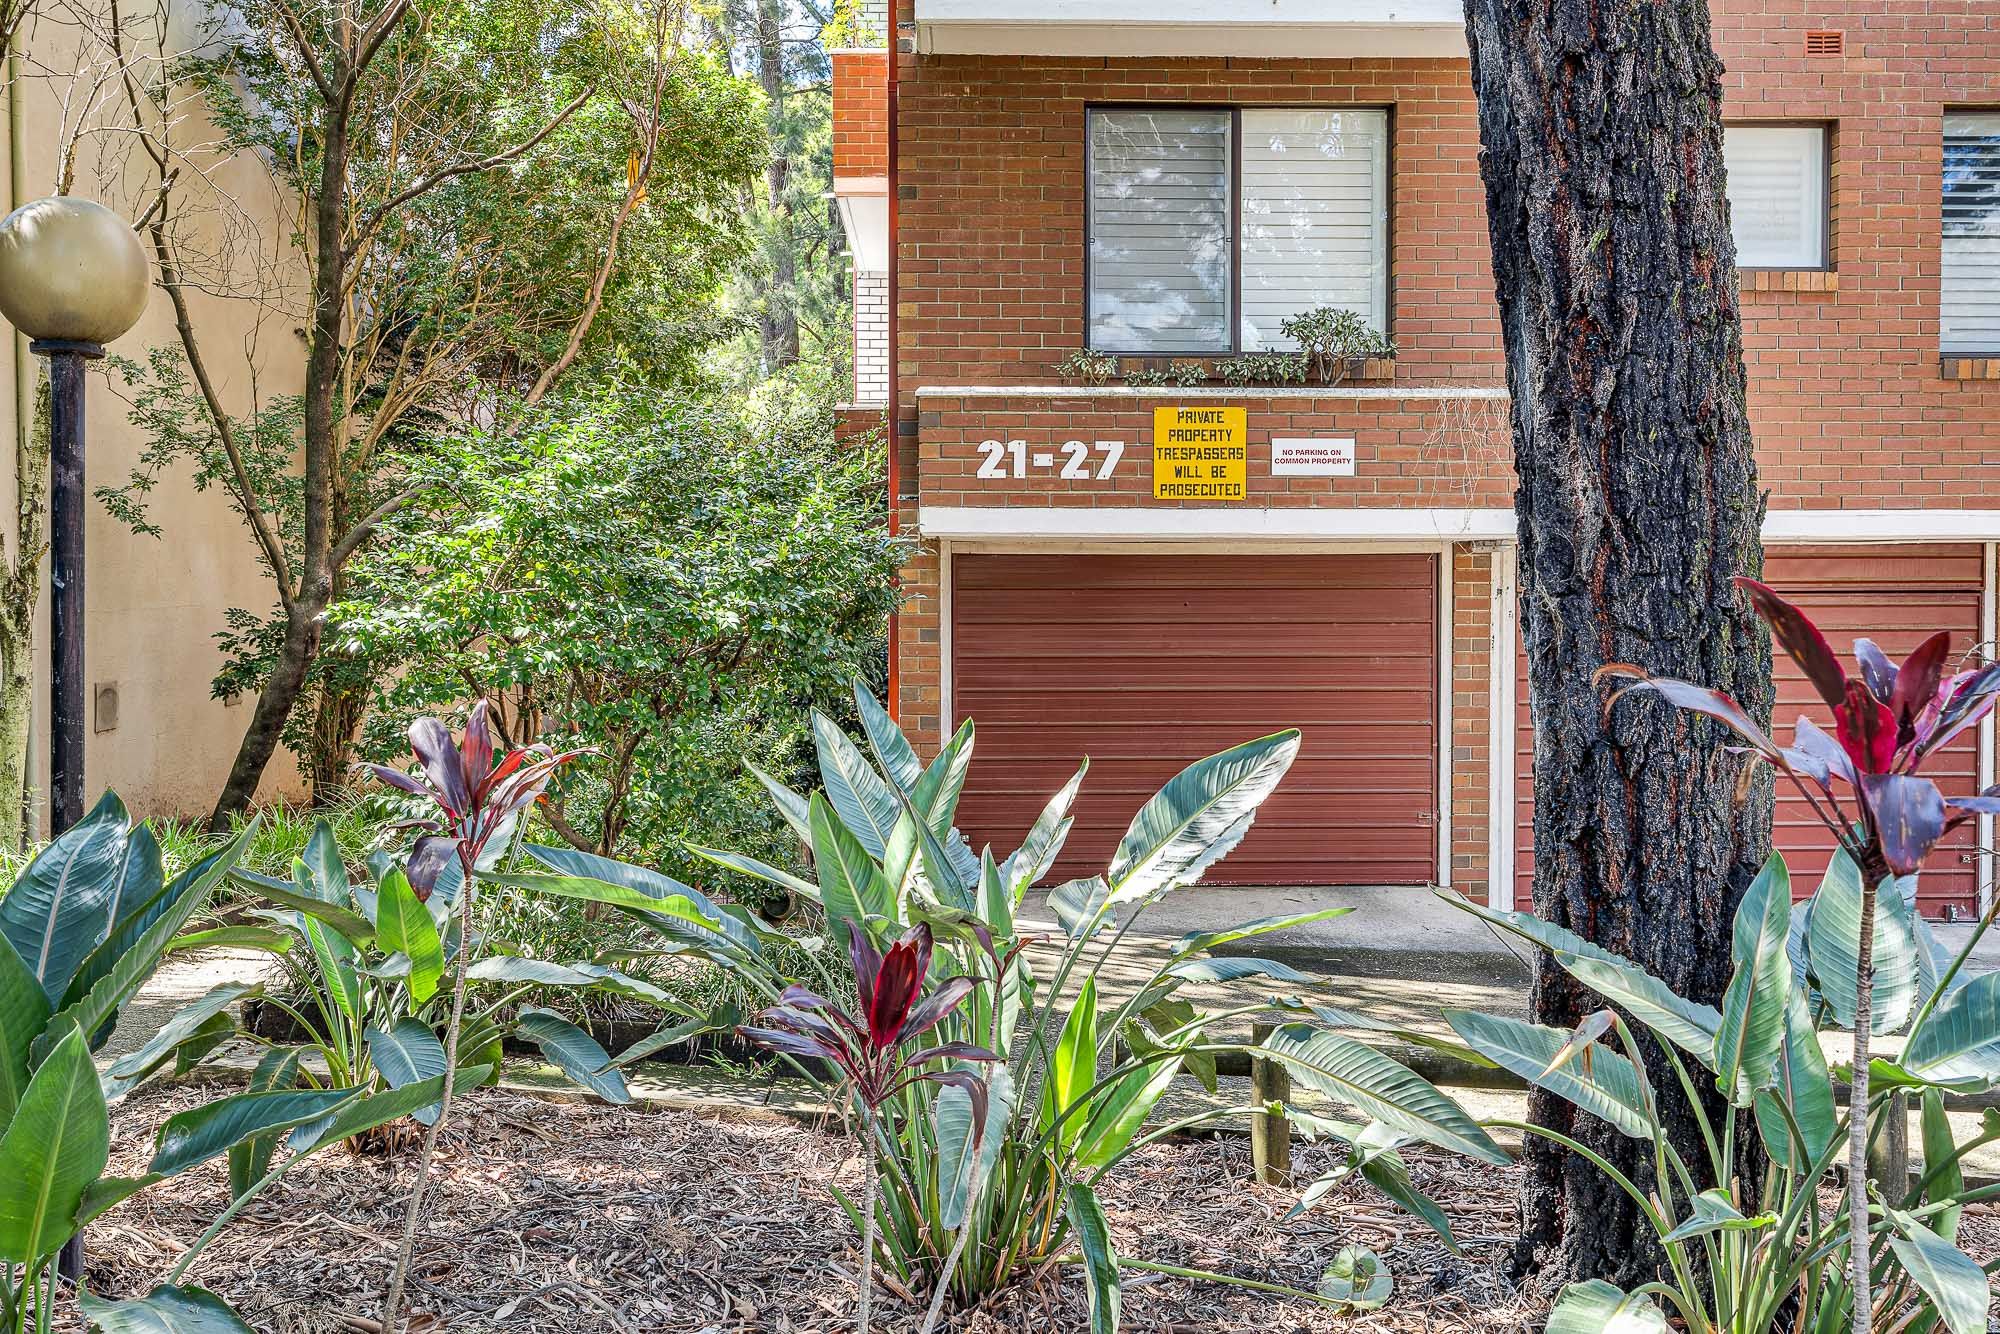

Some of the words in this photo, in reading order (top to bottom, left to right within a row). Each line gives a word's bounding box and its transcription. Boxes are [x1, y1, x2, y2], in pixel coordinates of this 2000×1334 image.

[1177, 411, 1225, 424] PRIVATE
[1168, 429, 1232, 442] PROPERTY
[976, 440, 1125, 480] 21-27
[1156, 447, 1244, 460] TRESPASSERS
[1174, 465, 1203, 478] WILL
[1211, 465, 1227, 478] BE
[1160, 483, 1241, 496] PROSECUTED
